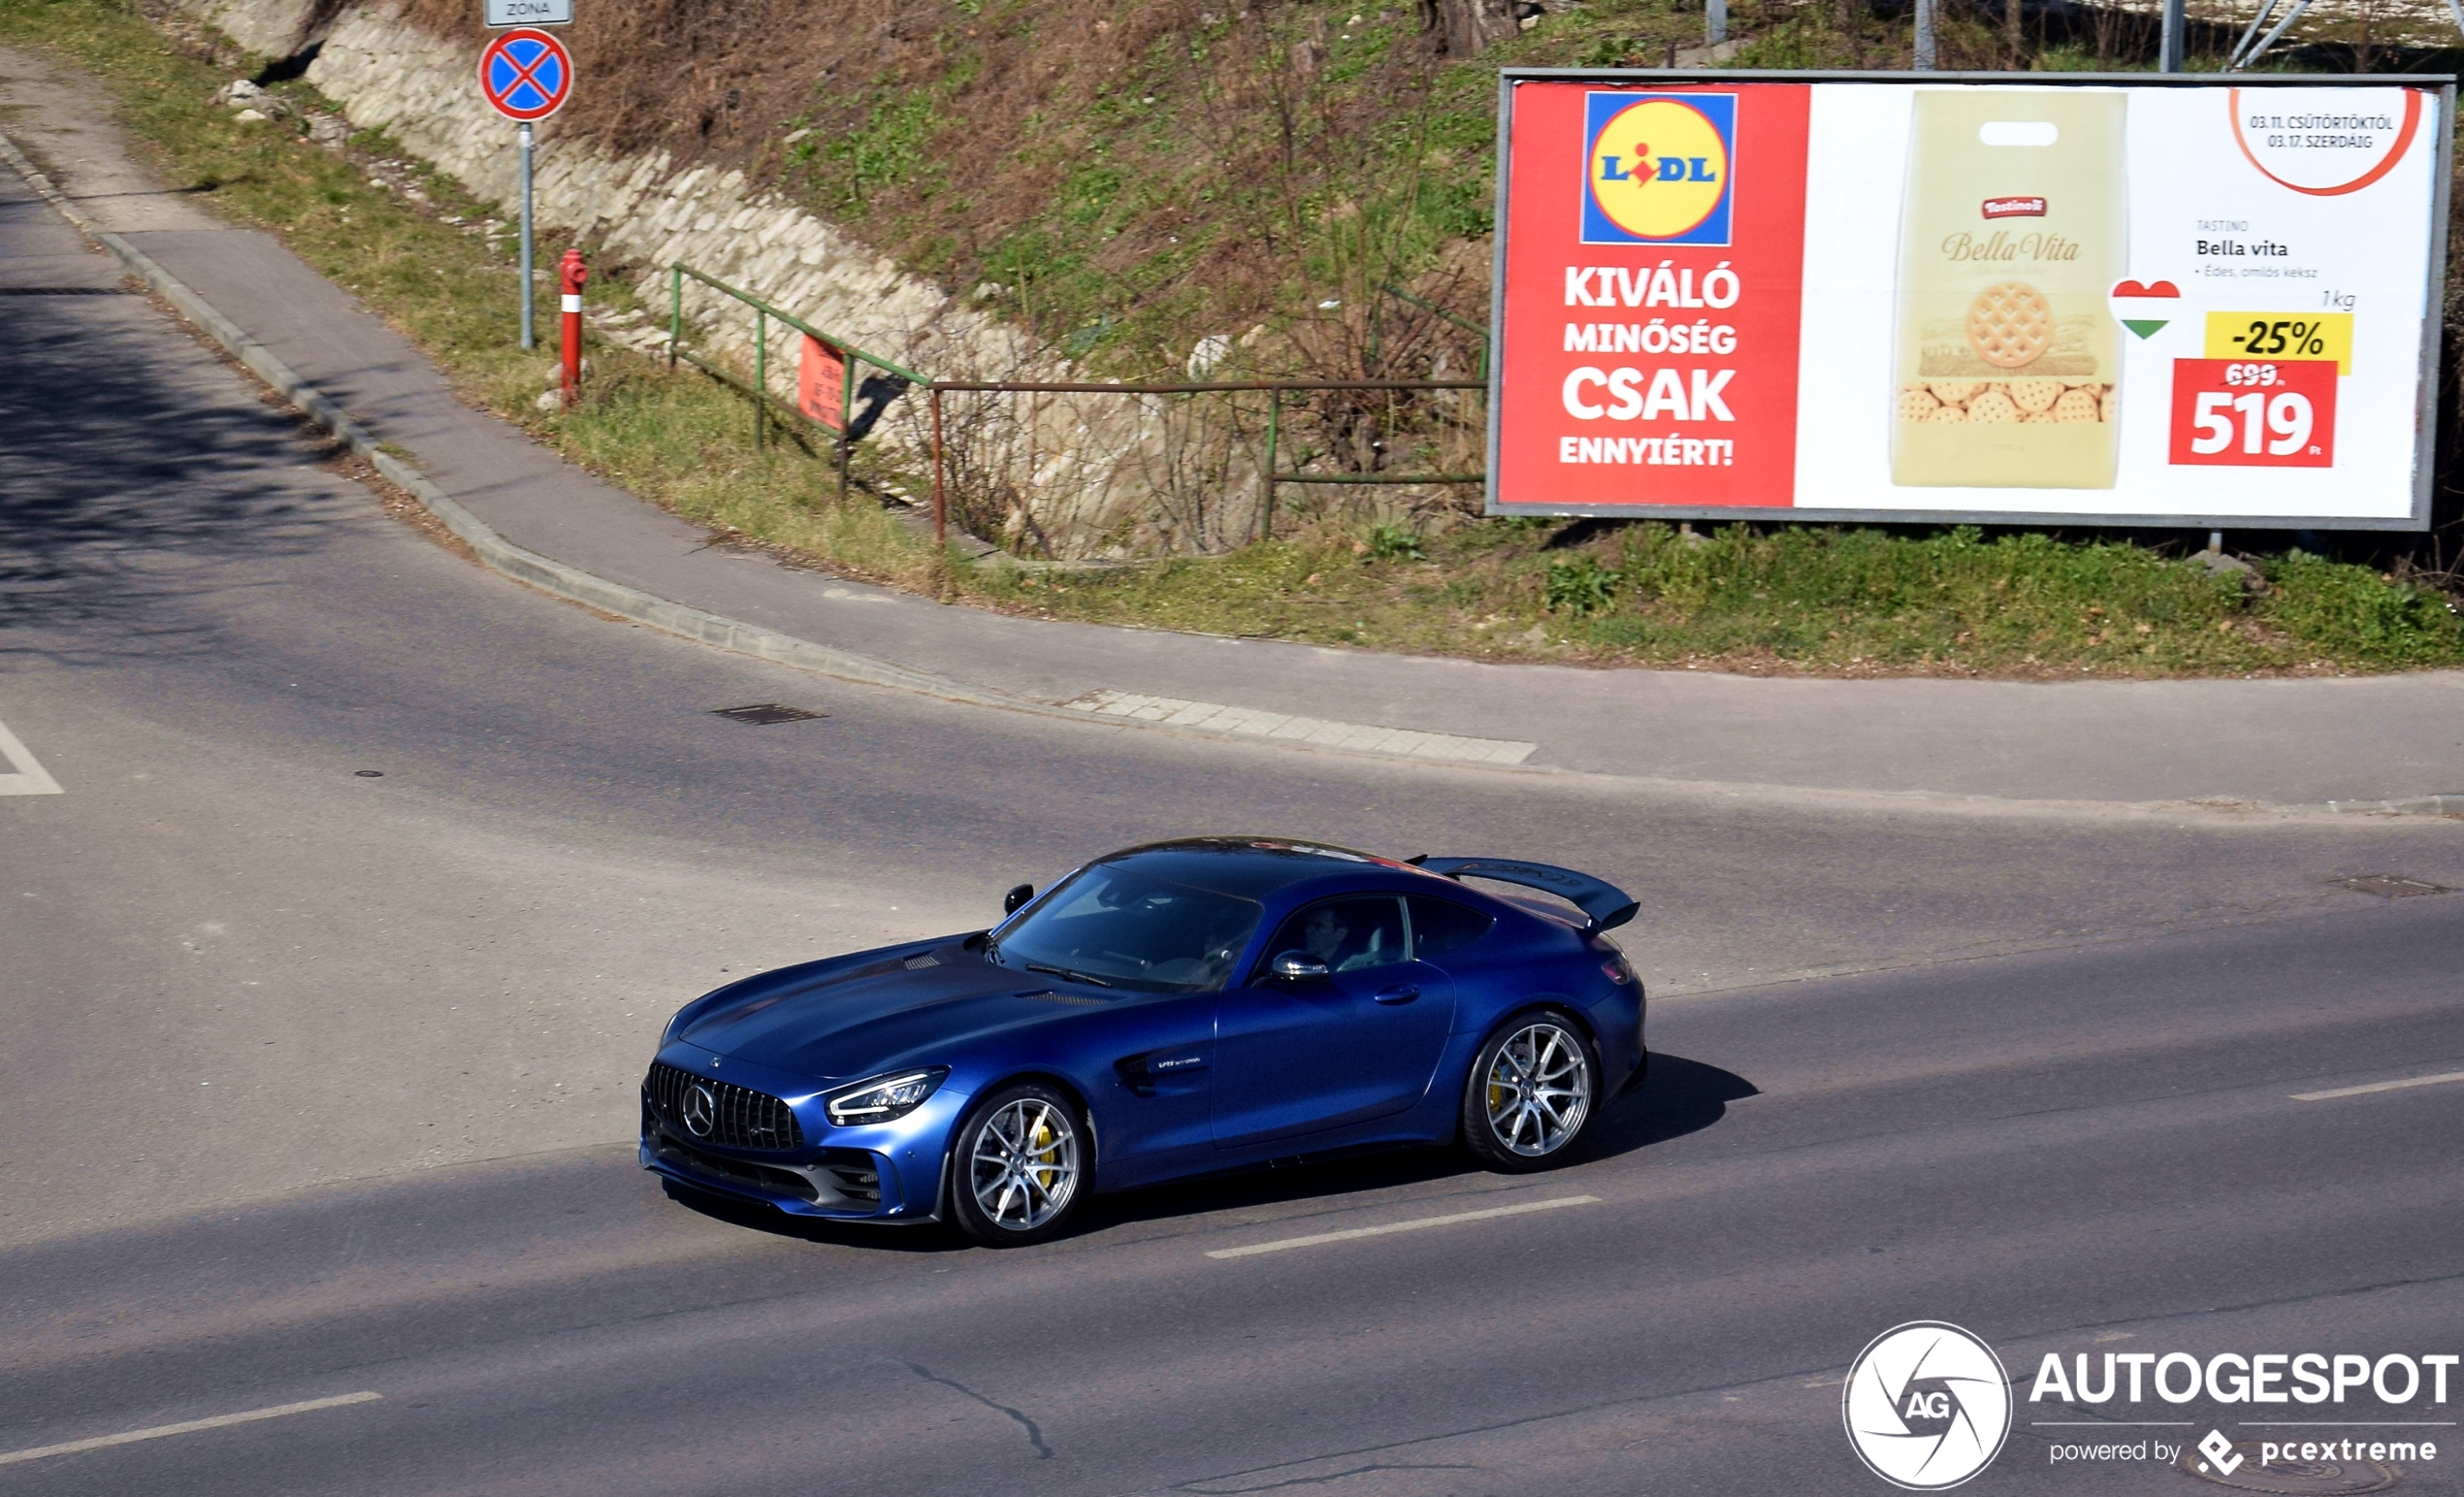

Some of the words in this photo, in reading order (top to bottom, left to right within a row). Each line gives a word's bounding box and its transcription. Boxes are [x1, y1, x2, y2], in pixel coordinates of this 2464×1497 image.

[2250, 115, 2268, 129] 03.
[2268, 135, 2286, 147] 03.
[2289, 135, 2303, 147] 17.
[2306, 133, 2373, 148] SZERDÁIG
[2197, 219, 2249, 232] TASTINO
[1941, 231, 2017, 262] Bella
[2019, 233, 2080, 261] Vita
[2196, 240, 2246, 255] Bella
[2252, 240, 2288, 256] vita
[1564, 260, 1740, 309] KIVÁLÓ
[2284, 267, 2318, 277] keksz
[1563, 318, 1737, 355] MINŐSÉG
[2232, 320, 2324, 355] -25%
[1561, 366, 1736, 421] CSAK
[2190, 391, 2314, 456] 519
[1559, 434, 1734, 467] ENNYIÉRT!
